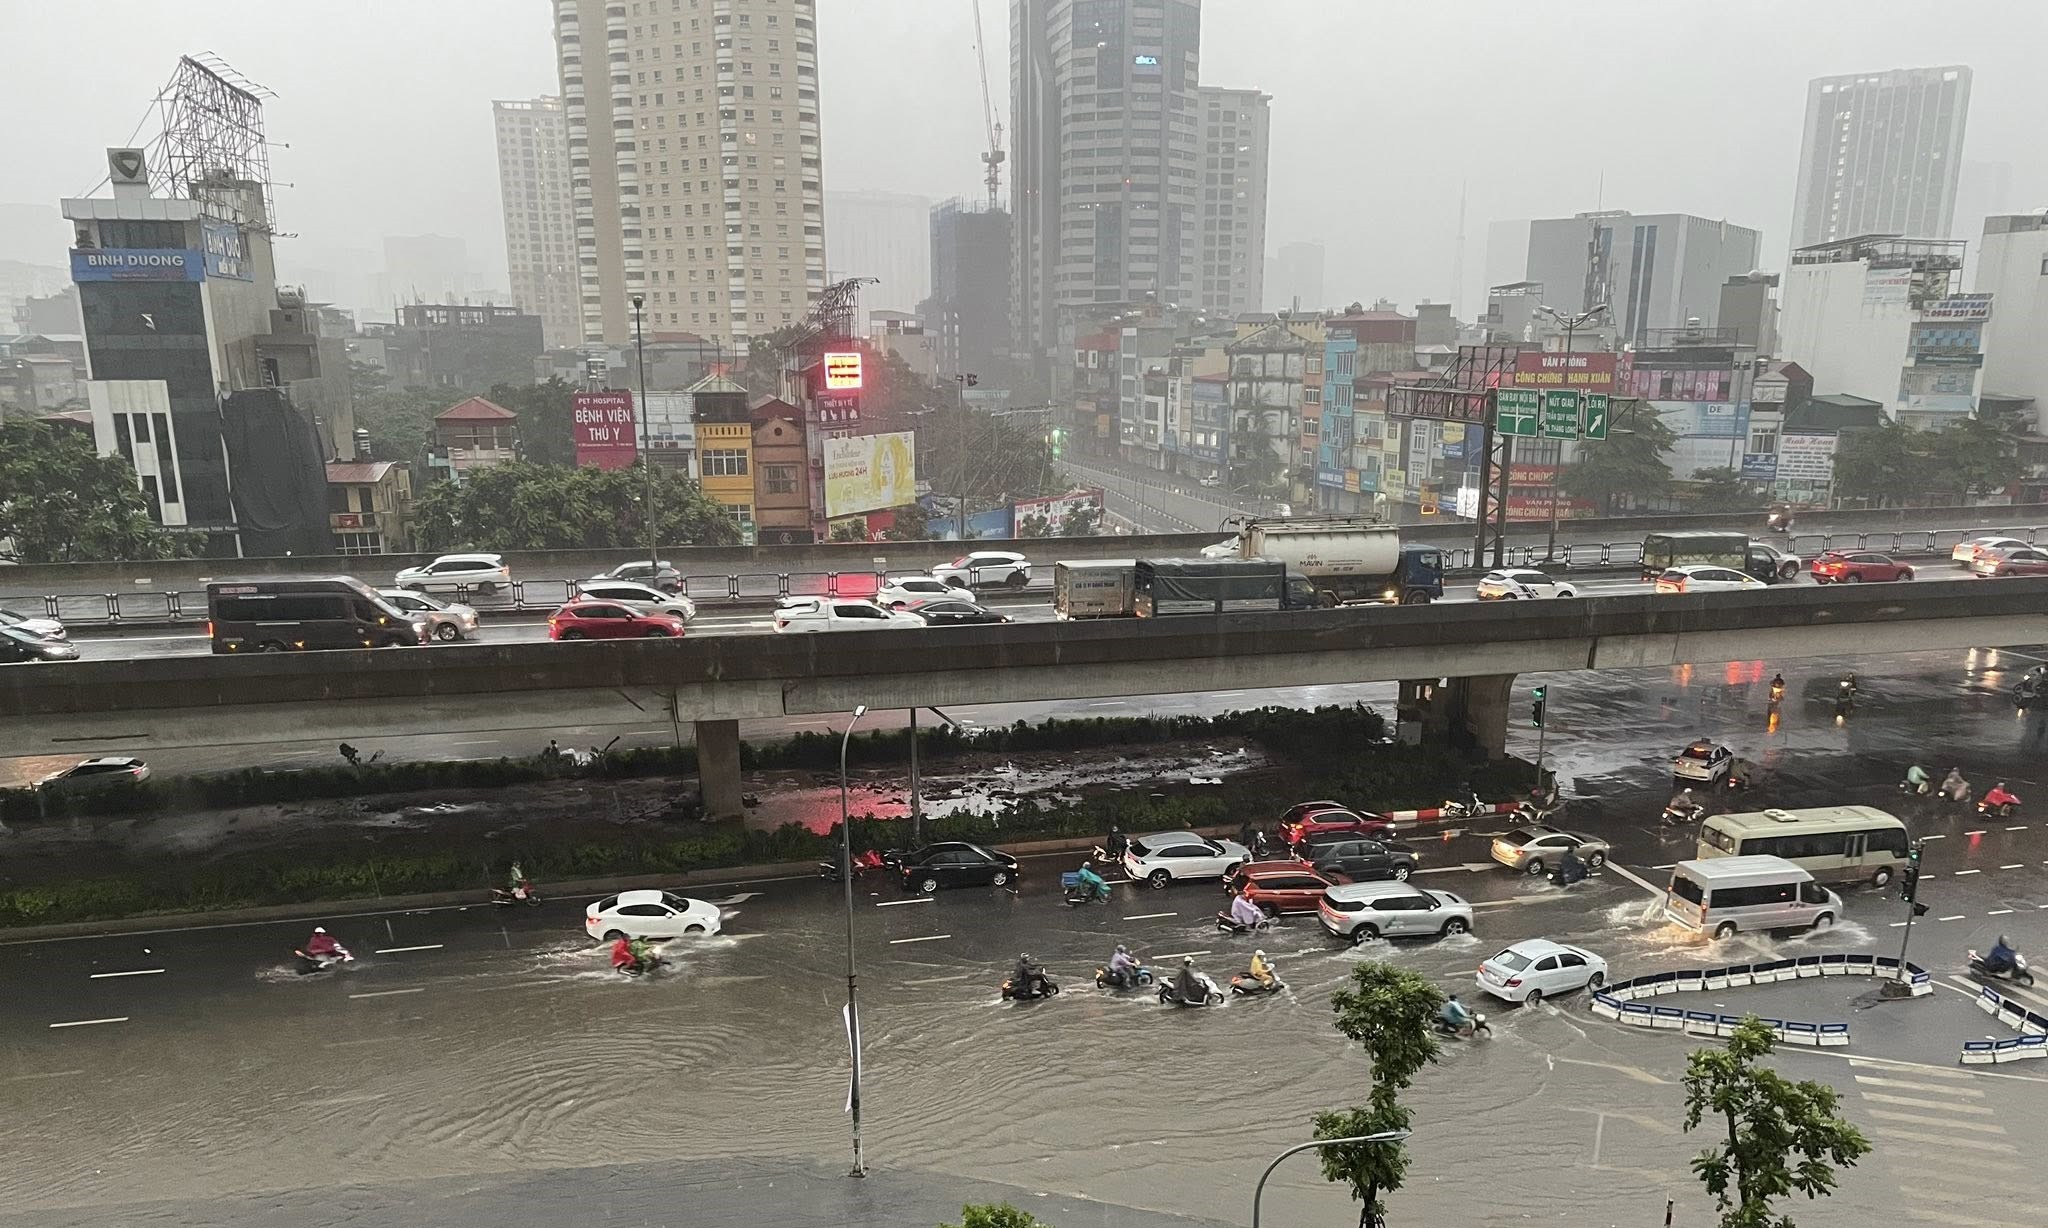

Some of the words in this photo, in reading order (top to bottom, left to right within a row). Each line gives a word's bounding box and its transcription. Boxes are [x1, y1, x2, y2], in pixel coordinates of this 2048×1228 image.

[88, 255, 123, 266] BINH
[128, 255, 184, 267] DUONG
[1542, 356, 1558, 367] VĂN
[1515, 372, 1536, 384] CÔNG
[1566, 373, 1589, 384] HANH
[1590, 371, 1612, 383] XUÂN
[1549, 395, 1560, 407] NÚT
[1561, 397, 1575, 408] GIAO
[1597, 400, 1606, 409] RA
[575, 407, 603, 425] BỆNH
[607, 406, 631, 425] VIỆN
[589, 424, 609, 441] THÚ
[613, 427, 620, 440] Y
[855, 466, 868, 477] 24H
